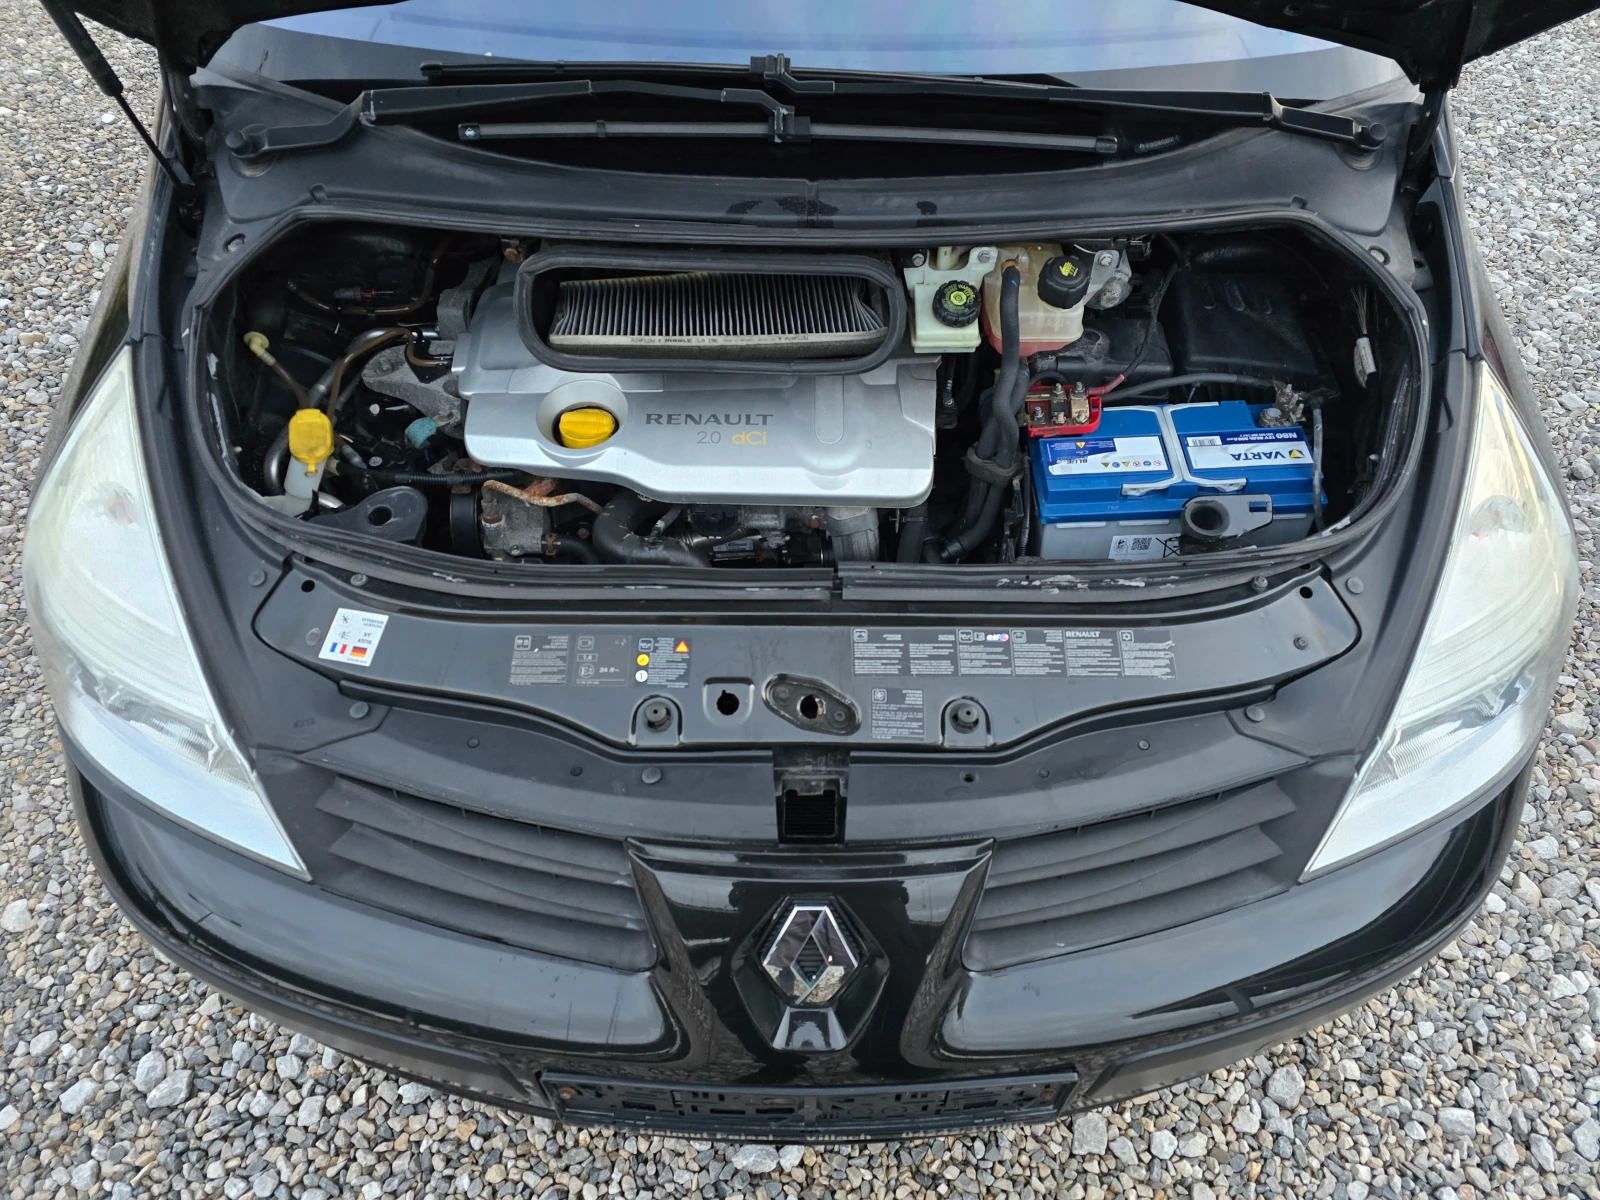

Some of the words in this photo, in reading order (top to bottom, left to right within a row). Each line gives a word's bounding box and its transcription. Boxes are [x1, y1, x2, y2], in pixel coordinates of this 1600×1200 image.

[645, 413, 774, 426] RENAULT
[696, 430, 722, 444] 2.0
[731, 430, 768, 445] dCi
[1230, 450, 1286, 461] VARTA
[1065, 630, 1100, 638] RENAULT
